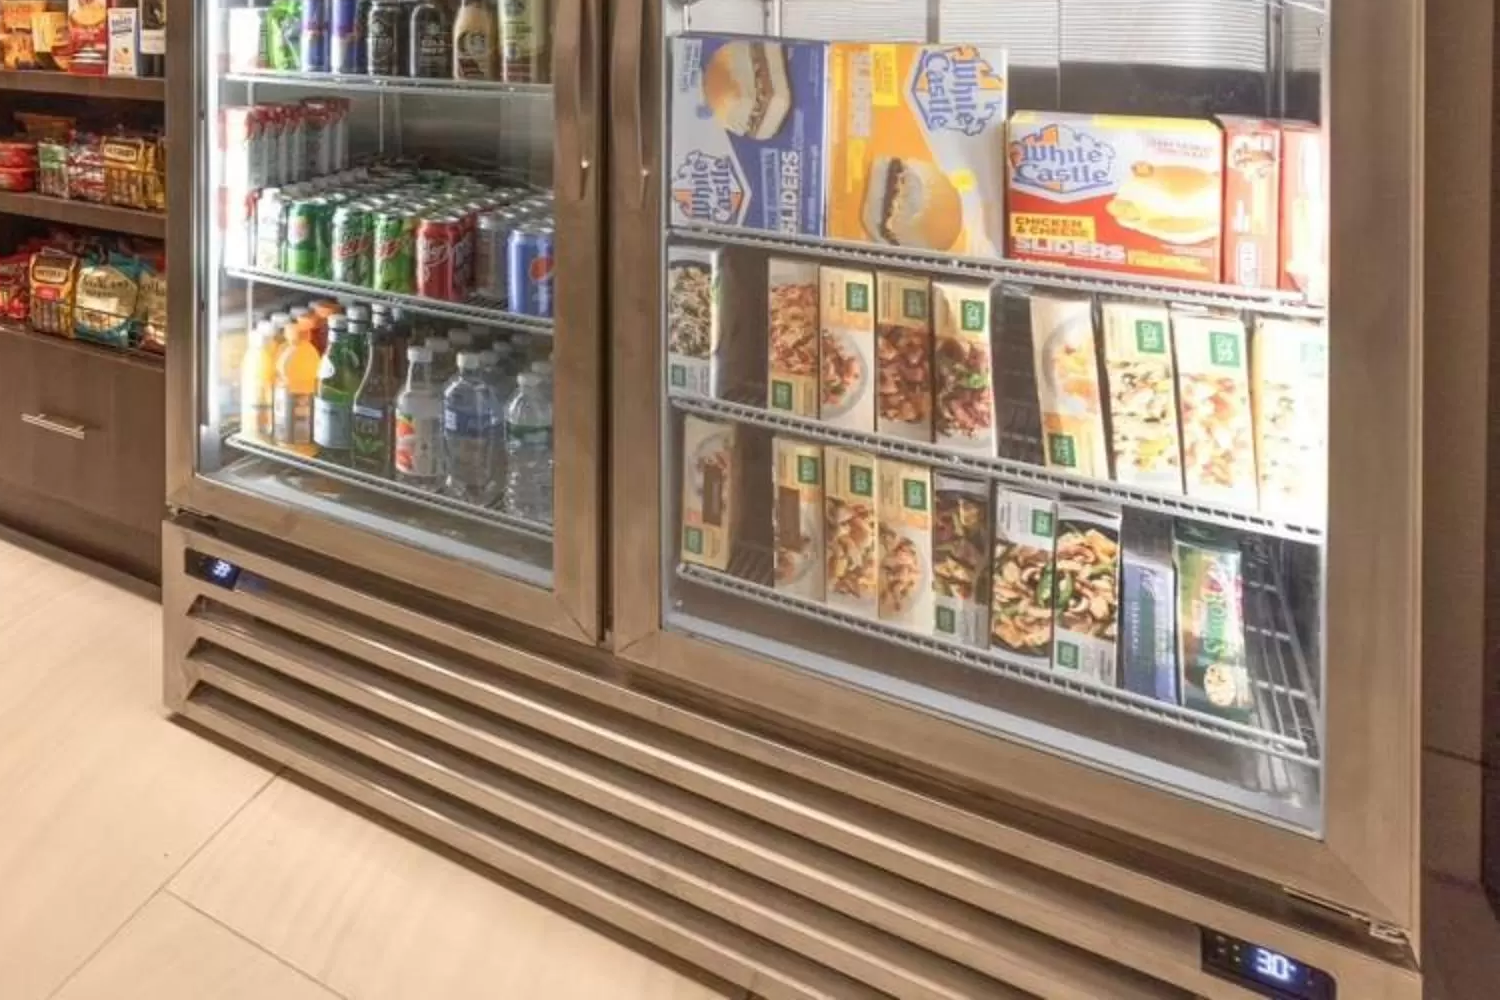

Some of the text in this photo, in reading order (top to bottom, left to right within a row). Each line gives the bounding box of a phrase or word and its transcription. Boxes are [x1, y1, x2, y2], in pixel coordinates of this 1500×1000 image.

[925, 51, 953, 132] Castle
[950, 58, 978, 126] White
[1013, 162, 1109, 184] Castle
[1023, 142, 1104, 166] White
[691, 157, 712, 220] White
[710, 155, 732, 222] Castle
[1015, 215, 1084, 228] CHICKEN
[1028, 227, 1090, 238] CHEESE
